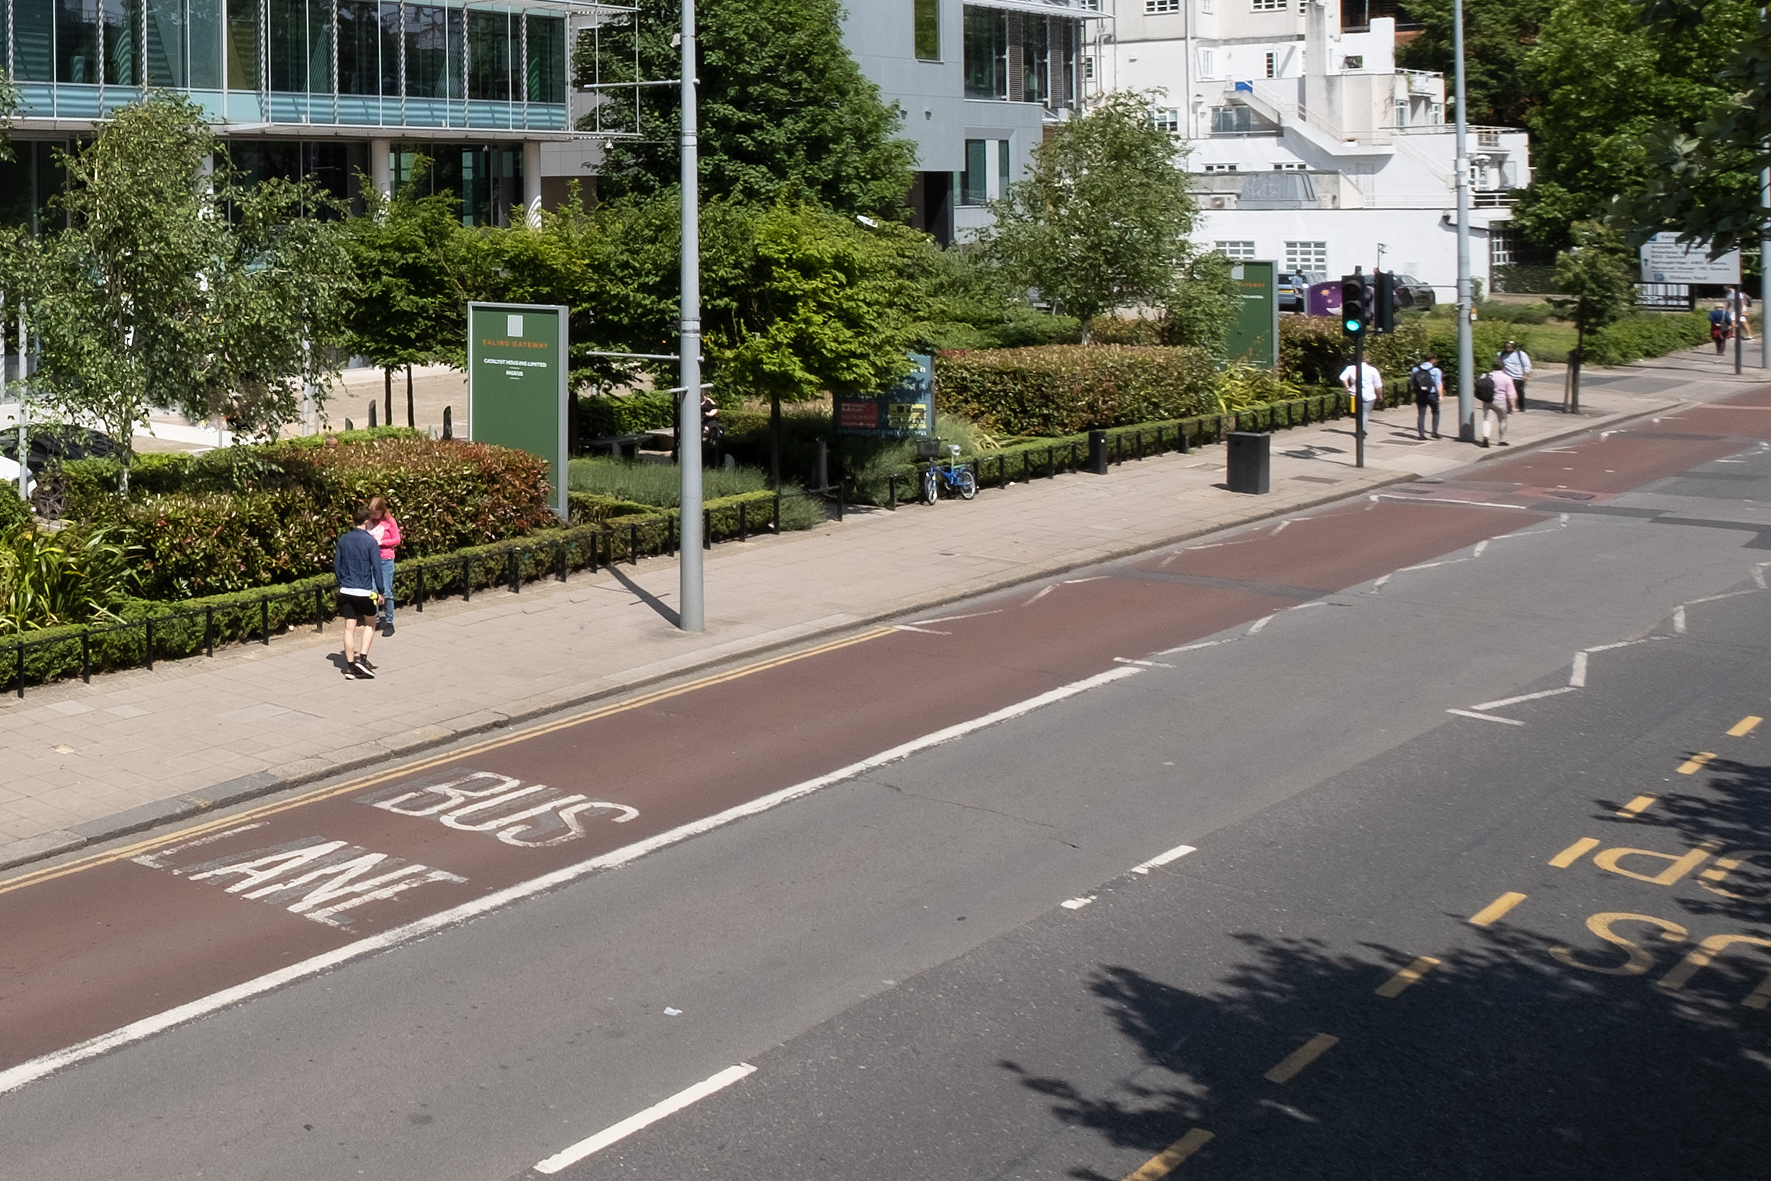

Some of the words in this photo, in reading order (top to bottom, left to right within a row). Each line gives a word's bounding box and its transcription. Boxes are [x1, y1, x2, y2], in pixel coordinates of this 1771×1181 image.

[482, 339, 510, 347] EALING
[512, 341, 548, 349] GATEWAY
[371, 770, 641, 849] BUS
[131, 822, 470, 934] LANE
